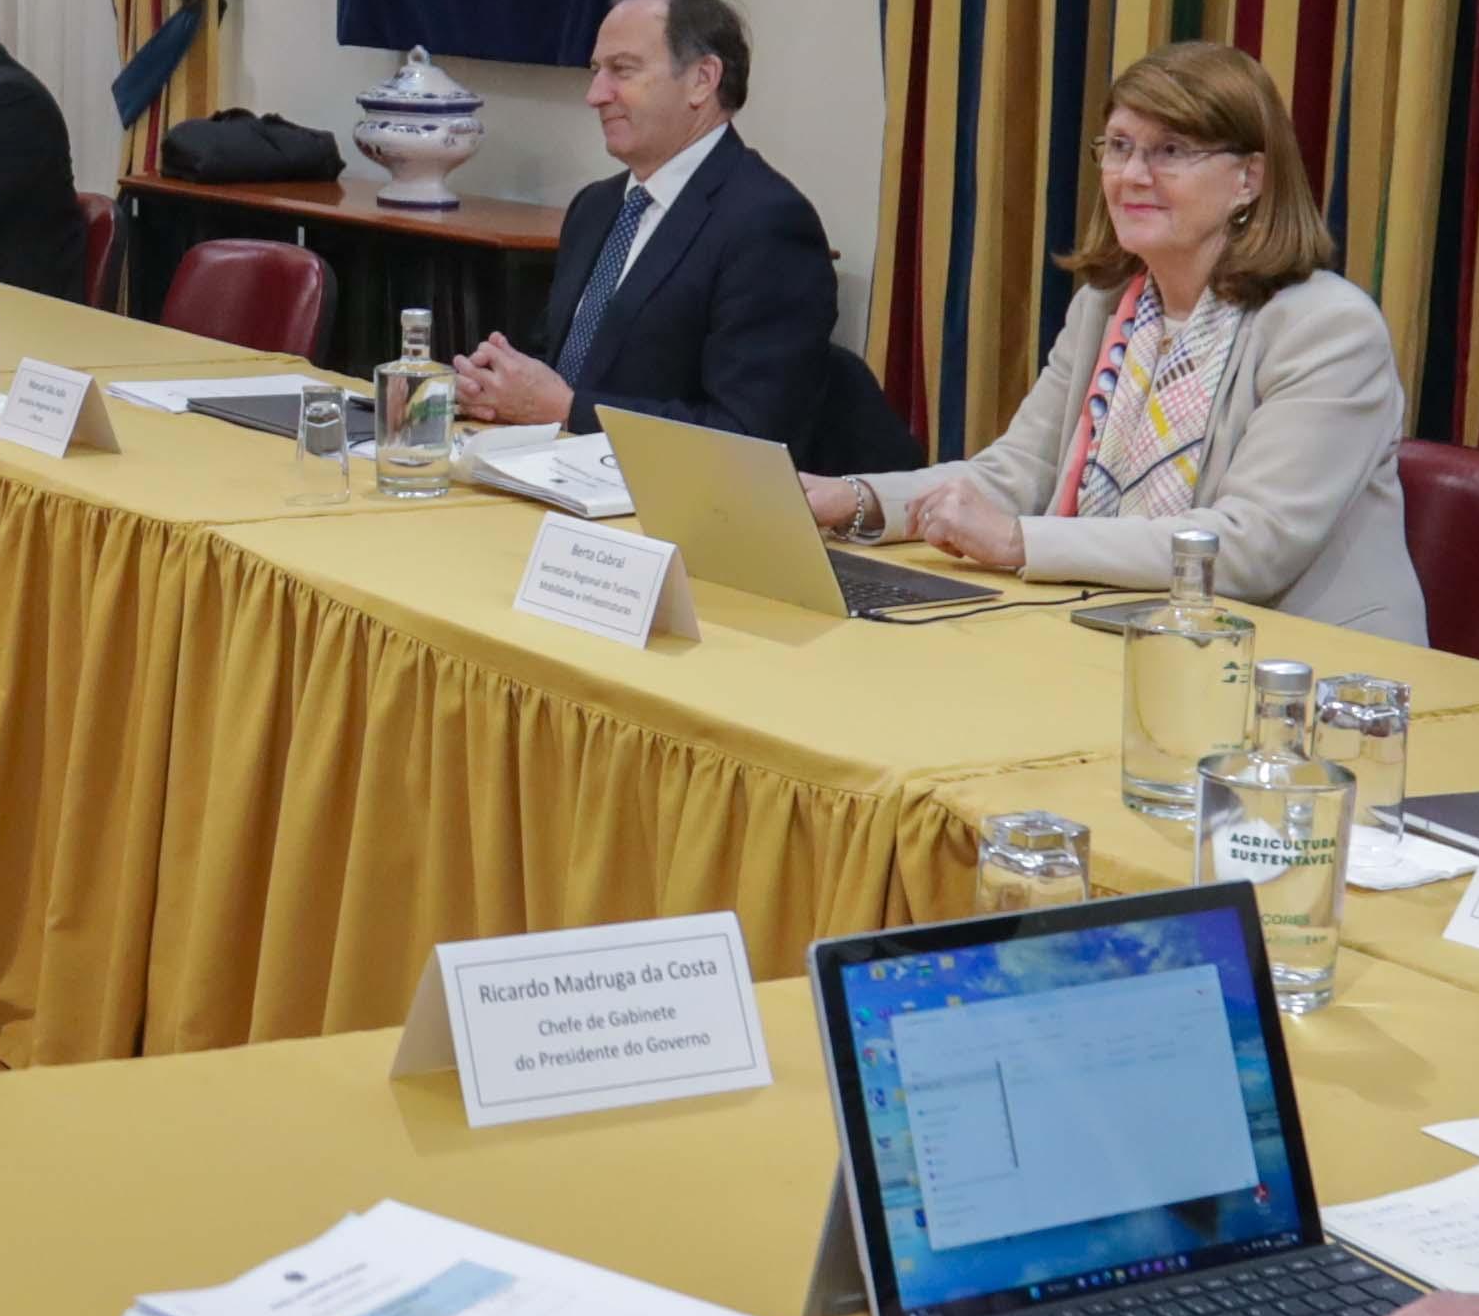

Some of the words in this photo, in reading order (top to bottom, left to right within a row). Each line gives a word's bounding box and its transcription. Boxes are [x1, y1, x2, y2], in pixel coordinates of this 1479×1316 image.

[571, 543, 595, 561] Berta
[596, 550, 625, 568] Cabral
[1230, 833, 1337, 851] AGRICULTURA
[1230, 848, 1334, 866] SUSTENTÁVEL
[478, 974, 550, 1004] Ricardo
[554, 969, 637, 995] Madruga
[641, 962, 664, 985] da
[667, 957, 718, 980] Costa
[538, 1013, 583, 1036] Chefe
[586, 1010, 606, 1031] de
[608, 1004, 677, 1028] Gabinete
[514, 1052, 536, 1072] do
[539, 1041, 620, 1068] Presidente
[623, 1036, 644, 1057] do
[646, 1030, 711, 1055] Governo
